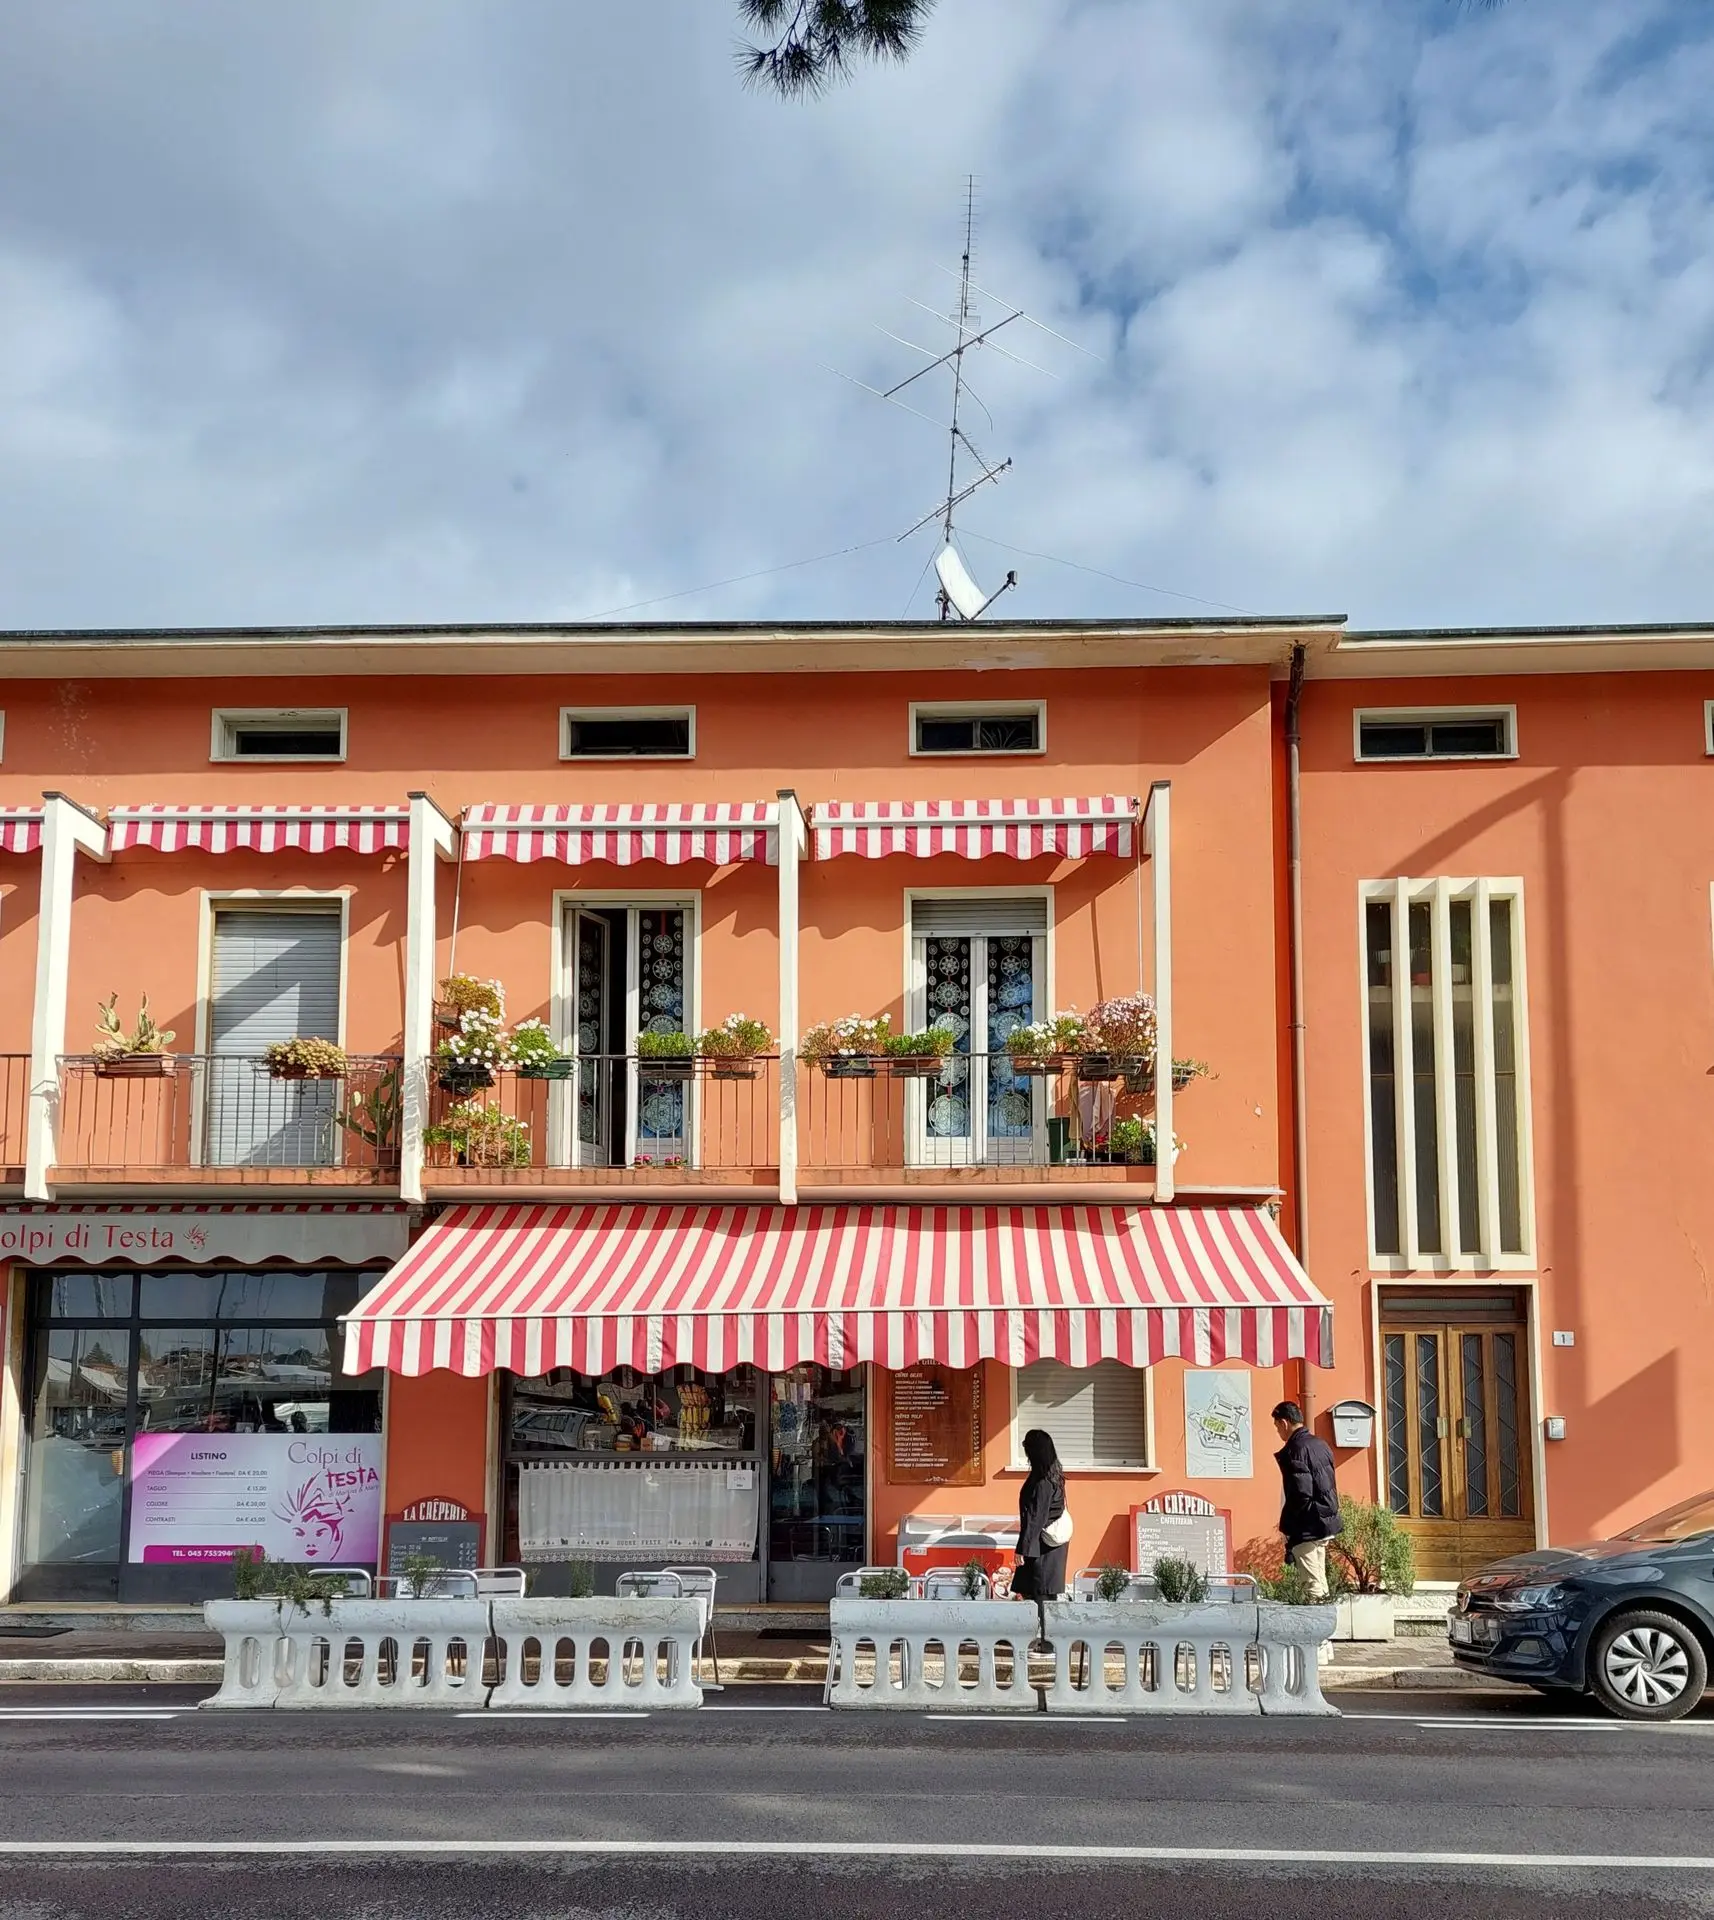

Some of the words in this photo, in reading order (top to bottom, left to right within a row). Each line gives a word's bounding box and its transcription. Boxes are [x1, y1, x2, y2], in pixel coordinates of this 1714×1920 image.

[0, 1224, 53, 1254] olpi
[65, 1224, 90, 1248] di
[102, 1225, 173, 1248] Testa
[190, 1452, 227, 1460] LISTINO
[288, 1441, 338, 1469] Colpi
[345, 1447, 361, 1464] di
[325, 1465, 378, 1490] TESTA
[403, 1506, 416, 1521] LA
[419, 1498, 468, 1521] CRÊPERIE
[1146, 1499, 1160, 1513] LA
[1163, 1491, 1216, 1516] CRÊPERIE
